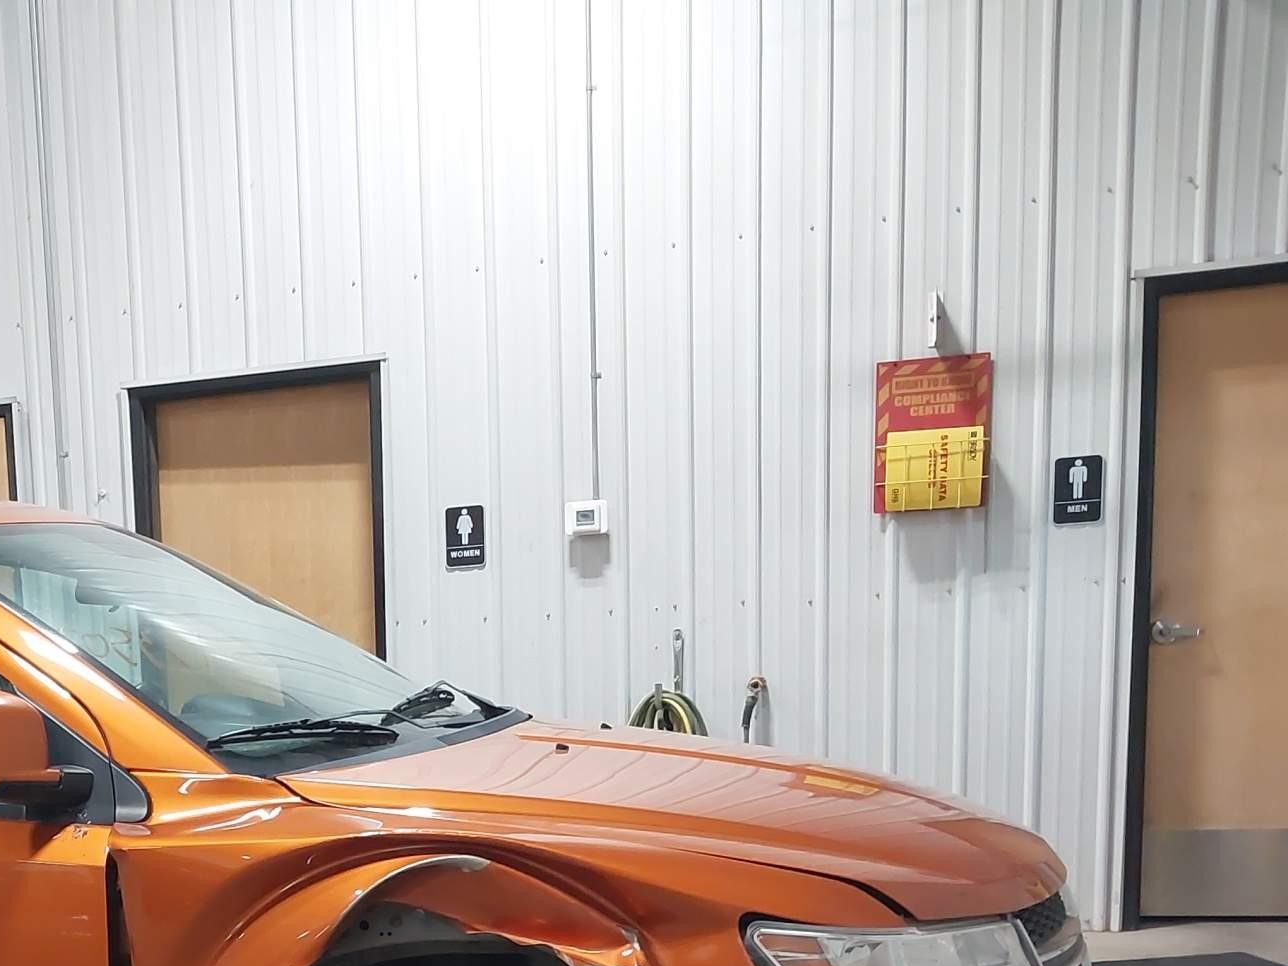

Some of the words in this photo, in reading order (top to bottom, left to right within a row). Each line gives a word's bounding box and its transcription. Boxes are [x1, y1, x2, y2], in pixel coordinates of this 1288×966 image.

[910, 403, 955, 416] CENTER
[1067, 504, 1088, 513] MEN
[450, 549, 480, 559] WOMEN
